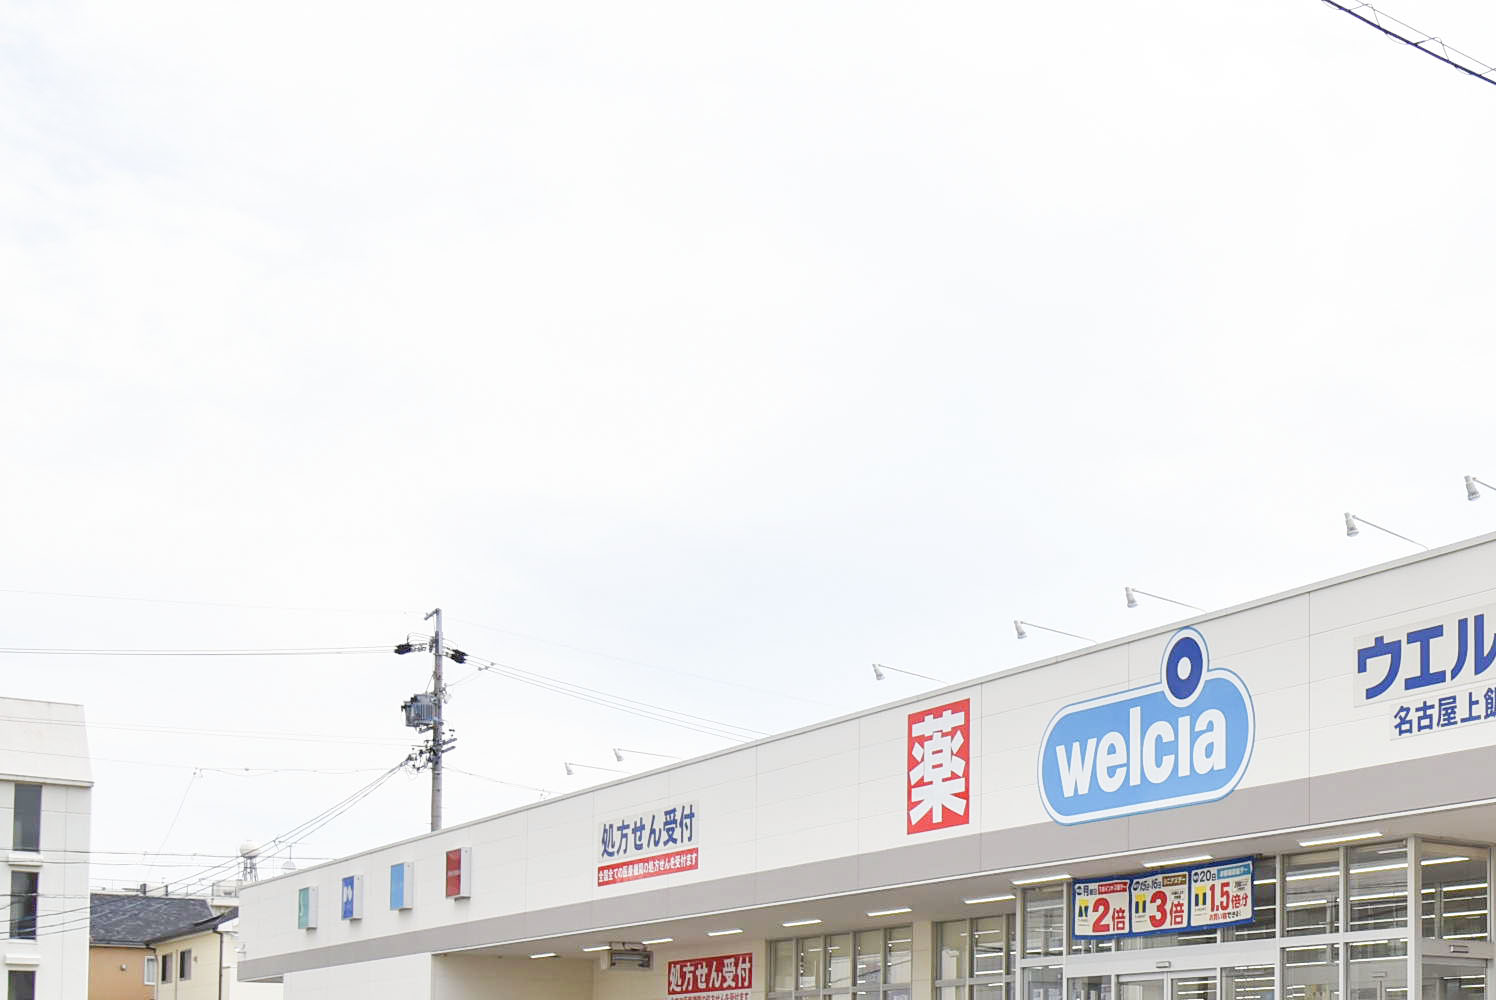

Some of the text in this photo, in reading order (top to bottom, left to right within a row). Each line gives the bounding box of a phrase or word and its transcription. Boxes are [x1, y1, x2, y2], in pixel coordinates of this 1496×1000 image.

[909, 709, 967, 825] 薬
[1056, 706, 1227, 798] welcia
[602, 804, 695, 858] 処方せん受付
[669, 957, 751, 992] 処方せん受付
